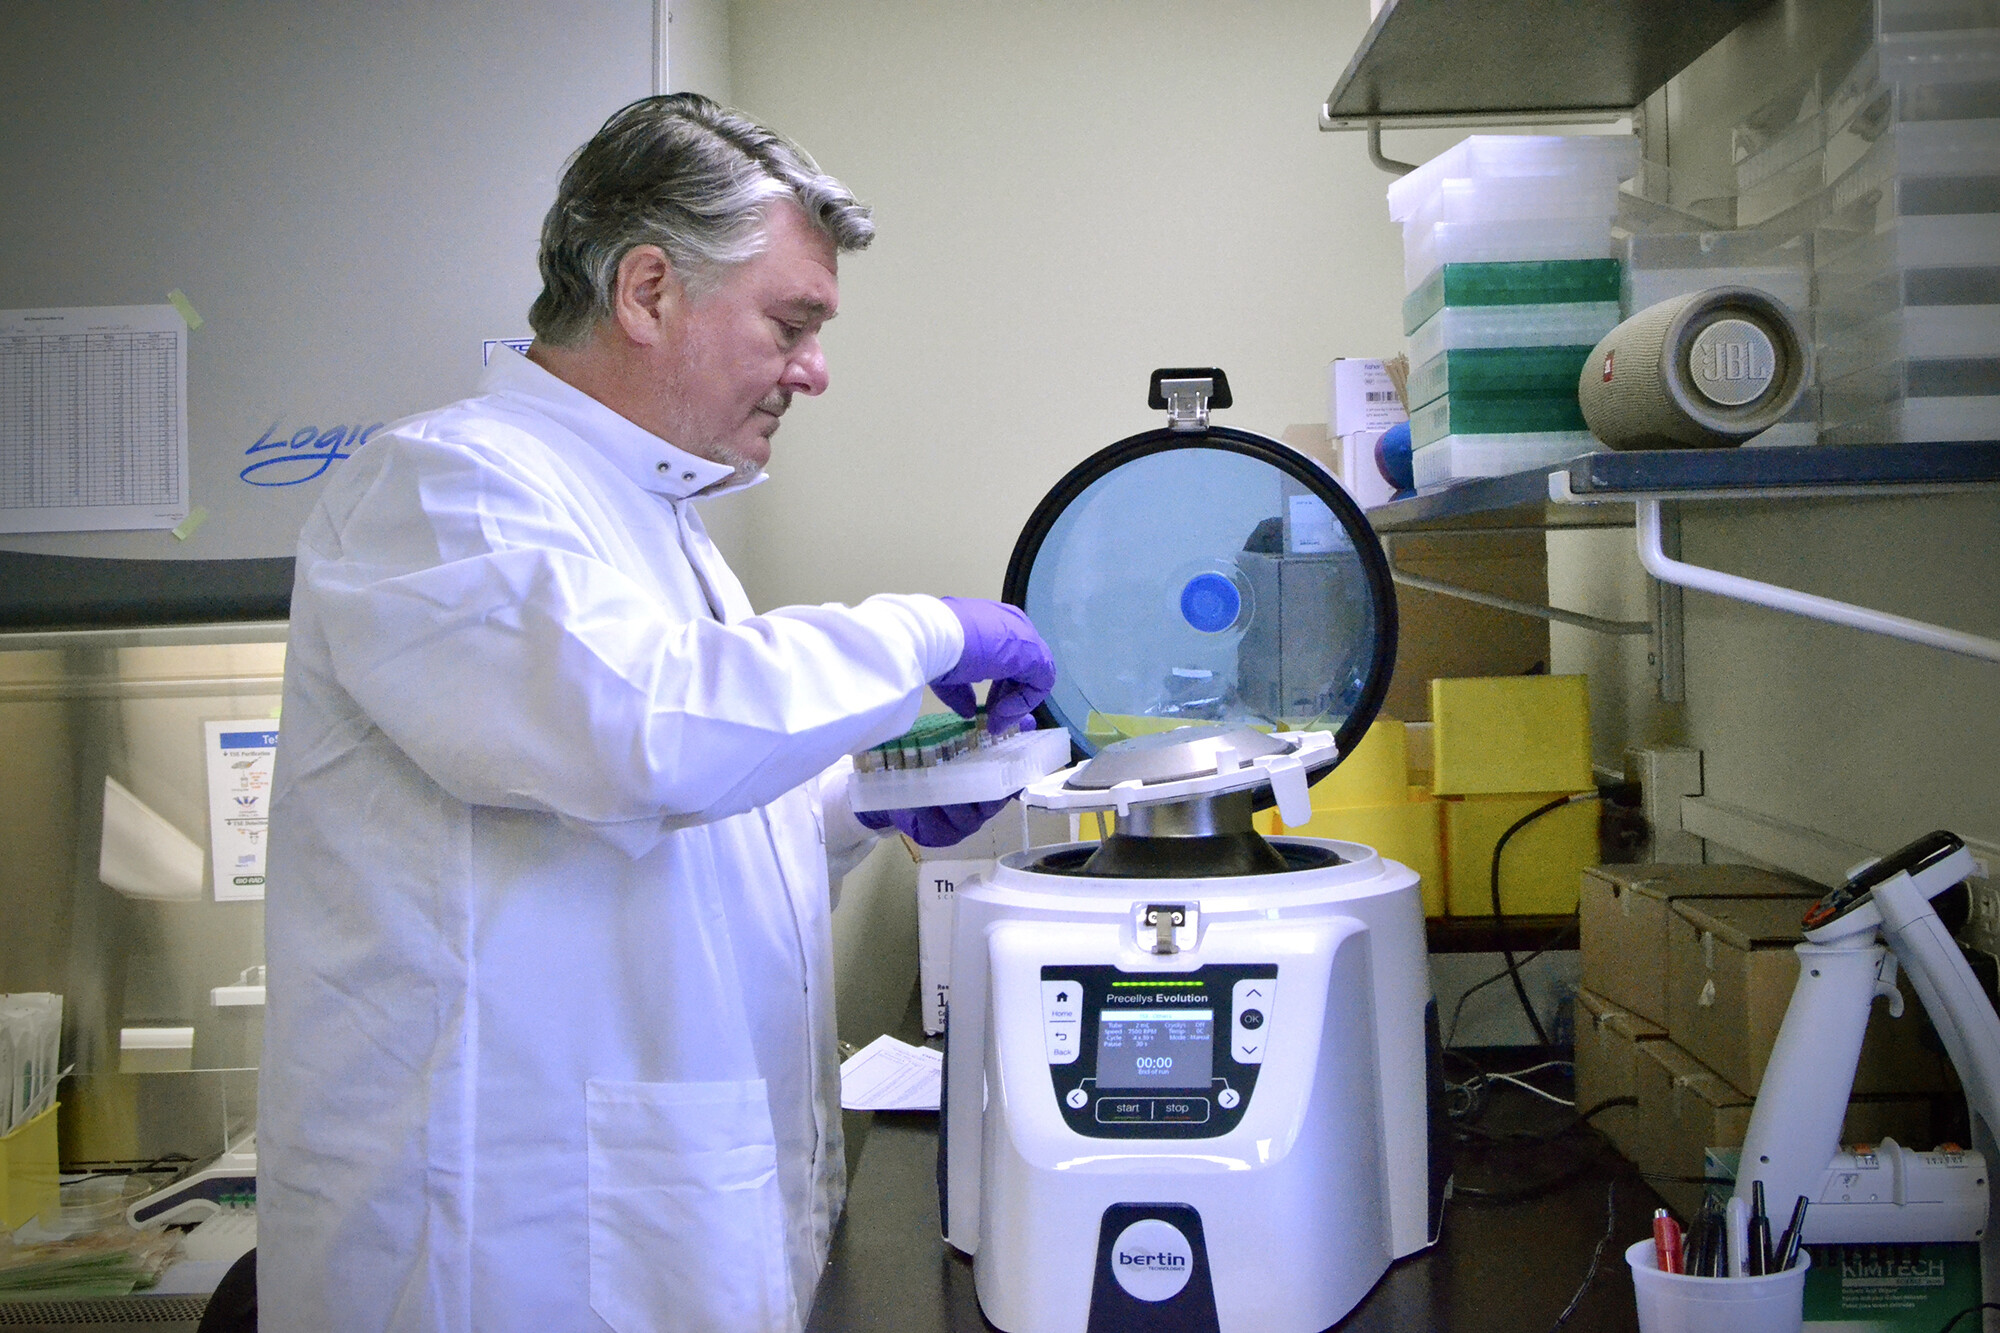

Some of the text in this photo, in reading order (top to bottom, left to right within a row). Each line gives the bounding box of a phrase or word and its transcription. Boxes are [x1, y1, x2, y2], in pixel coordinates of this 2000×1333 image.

[1700, 342, 1769, 381] JBL
[934, 879, 954, 893] Th
[1106, 993, 1208, 1004] Precellys Evolution
[1245, 1014, 1260, 1024] OK
[1053, 1048, 1072, 1056] Back
[1136, 1057, 1173, 1068] 00:00
[1116, 1103, 1140, 1112] start
[1165, 1103, 1190, 1114] stop
[1119, 1252, 1185, 1266] bertin
[1841, 1259, 1944, 1277] KIMTECH
